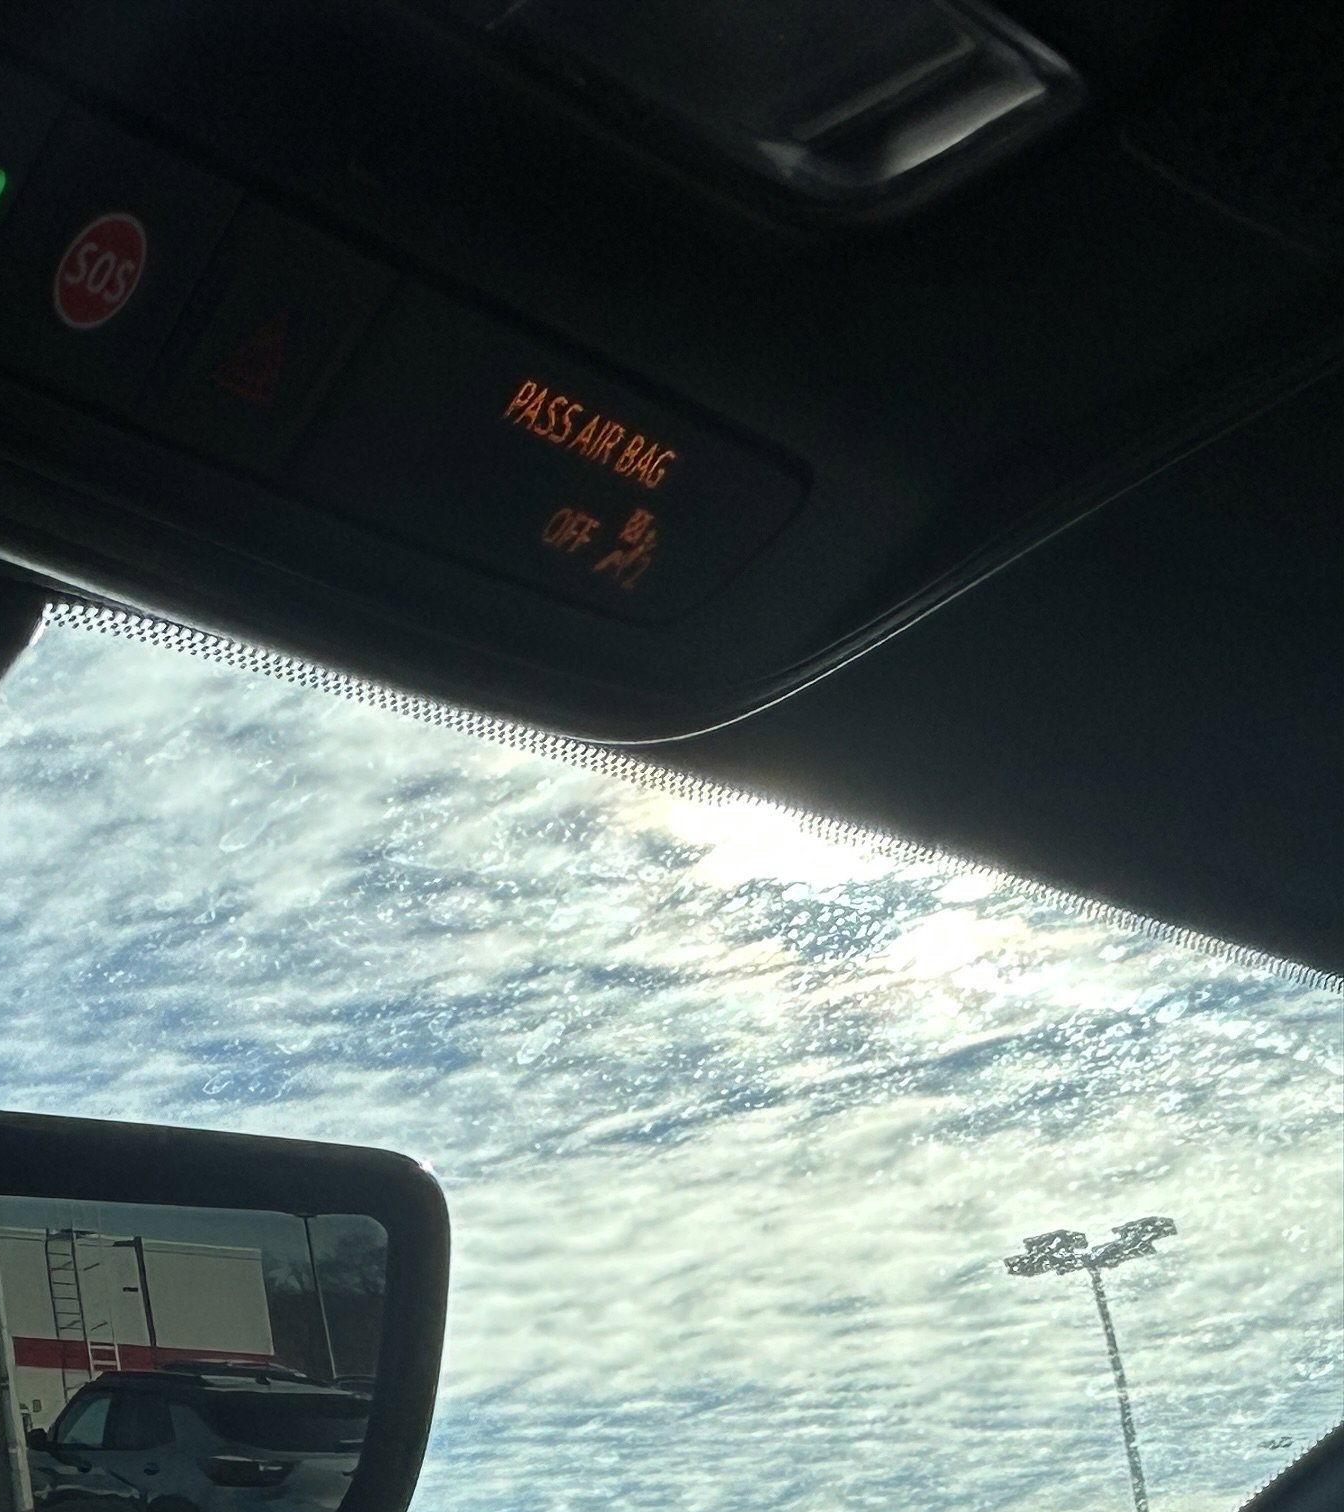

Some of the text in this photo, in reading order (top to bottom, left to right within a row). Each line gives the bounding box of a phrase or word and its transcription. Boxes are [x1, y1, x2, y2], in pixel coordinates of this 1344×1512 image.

[65, 242, 135, 301] SOS
[503, 380, 676, 488] PASS AIR BAG
[542, 508, 600, 552] OFF
